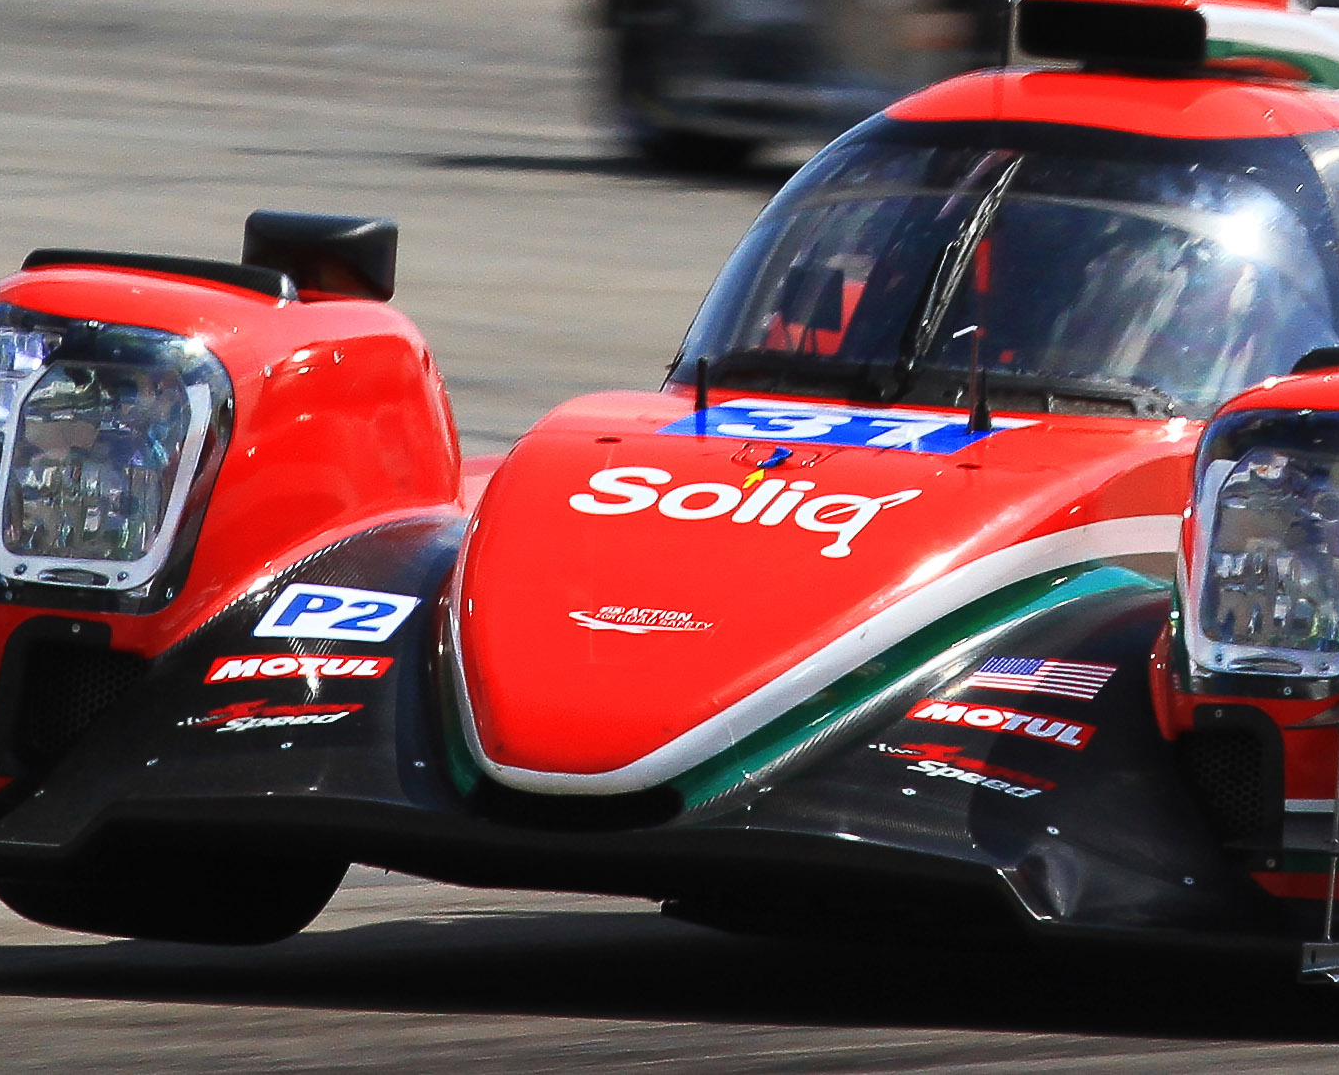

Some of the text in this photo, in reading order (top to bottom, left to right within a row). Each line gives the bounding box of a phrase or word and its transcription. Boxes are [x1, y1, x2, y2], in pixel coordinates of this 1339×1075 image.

[569, 466, 923, 558] Soliq
[272, 592, 398, 632] P2
[625, 608, 693, 622] ACTION
[211, 658, 380, 681] MOTUL
[914, 703, 1083, 746] MOTUL
[906, 760, 1044, 798] Speed
